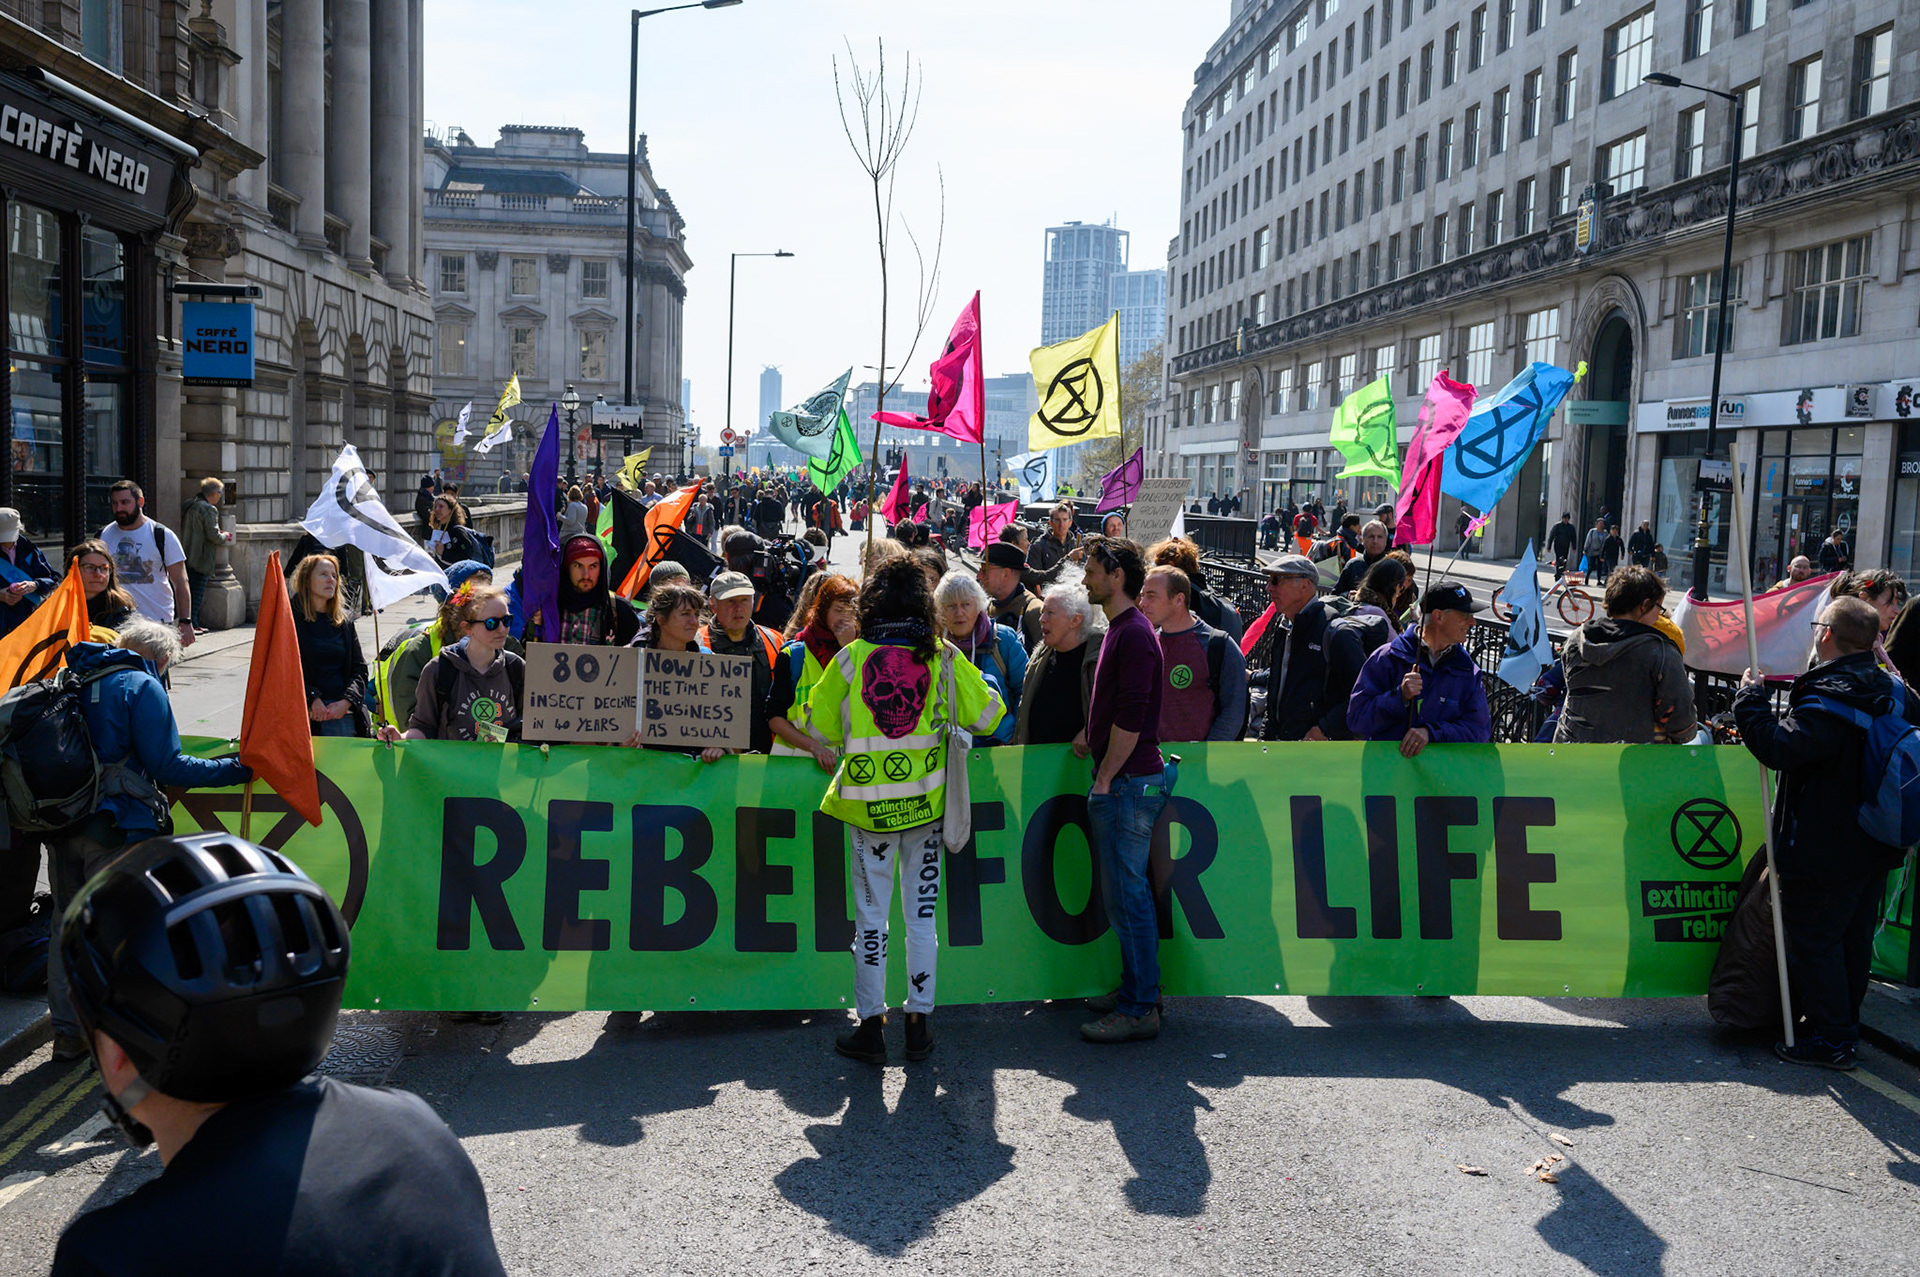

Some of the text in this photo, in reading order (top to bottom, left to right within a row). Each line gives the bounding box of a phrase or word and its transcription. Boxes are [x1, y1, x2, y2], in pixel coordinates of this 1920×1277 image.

[0, 104, 150, 195] CAFFÈ NERO
[196, 327, 237, 338] CAFFÈ
[186, 339, 249, 355] NERO
[1667, 405, 1711, 420] runnersnee
[1720, 400, 1744, 414] run
[1901, 461, 1920, 474] BRO
[645, 652, 695, 678] NOW
[644, 680, 671, 696] THE
[554, 718, 570, 731] 40
[576, 717, 620, 732] YEARS
[647, 722, 668, 738] AS
[869, 798, 920, 815] extinction
[886, 807, 931, 827] rebellion
[436, 792, 1563, 953] REBEL FOR LIFE
[1647, 883, 1739, 909] extinctio
[863, 929, 880, 967] NOW
